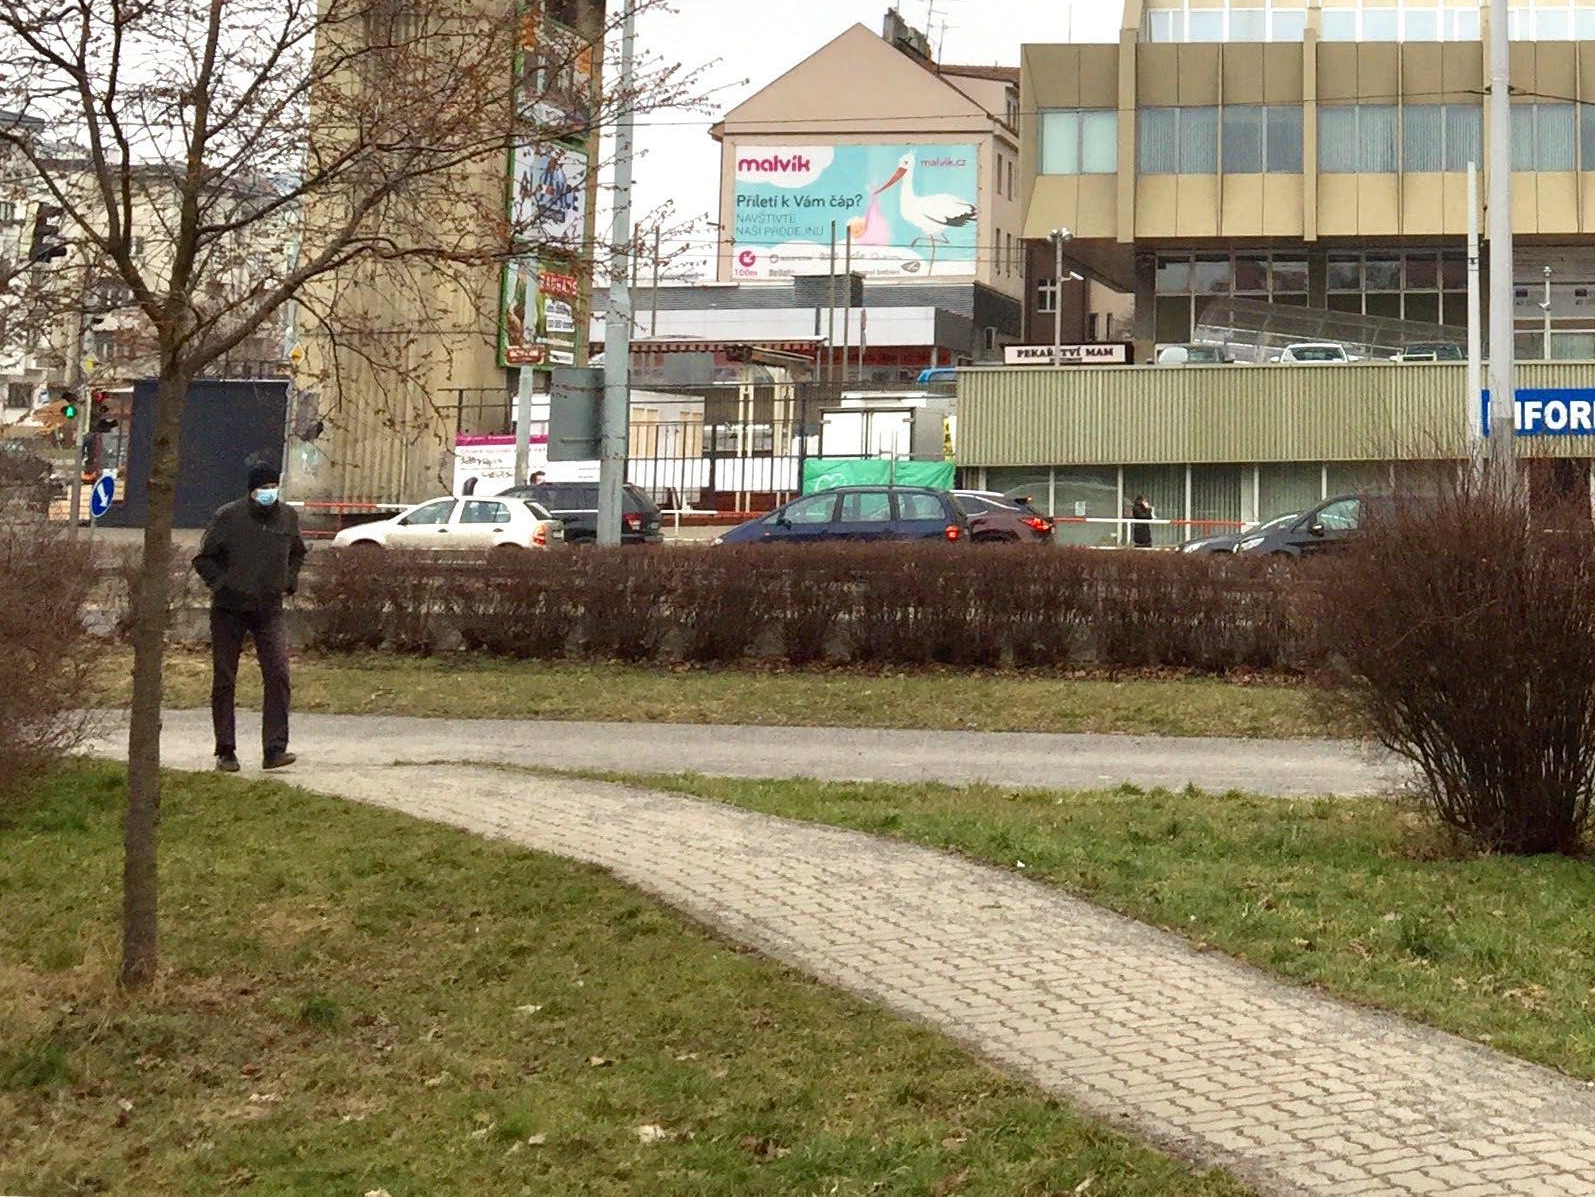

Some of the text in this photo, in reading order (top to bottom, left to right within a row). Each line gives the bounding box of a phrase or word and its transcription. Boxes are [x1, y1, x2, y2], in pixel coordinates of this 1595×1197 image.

[738, 155, 811, 173] malvík
[736, 193, 863, 209] Přiletí k Vám čáp?
[764, 226, 824, 236] PRODEJNU
[1017, 346, 1081, 358] PEKAŘTVÍ
